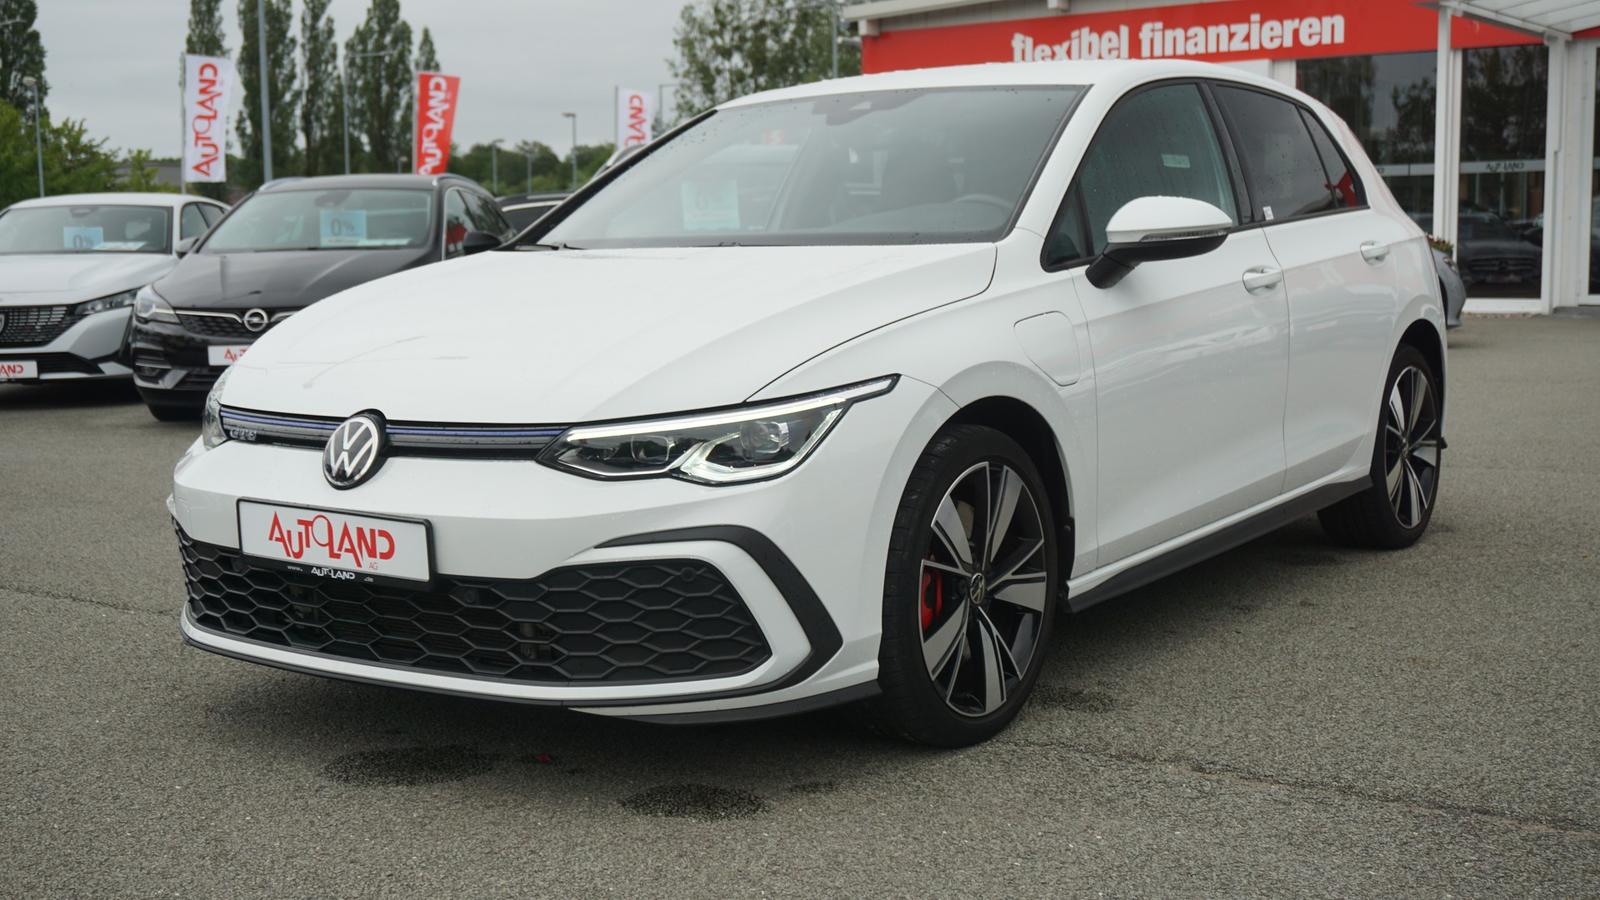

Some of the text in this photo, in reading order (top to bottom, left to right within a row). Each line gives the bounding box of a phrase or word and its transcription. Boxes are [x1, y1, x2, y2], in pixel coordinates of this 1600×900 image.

[1011, 14, 1345, 63] flexibel finanzieren
[192, 63, 222, 176] AUTOLAND
[268, 511, 395, 568] AUTOLAND
